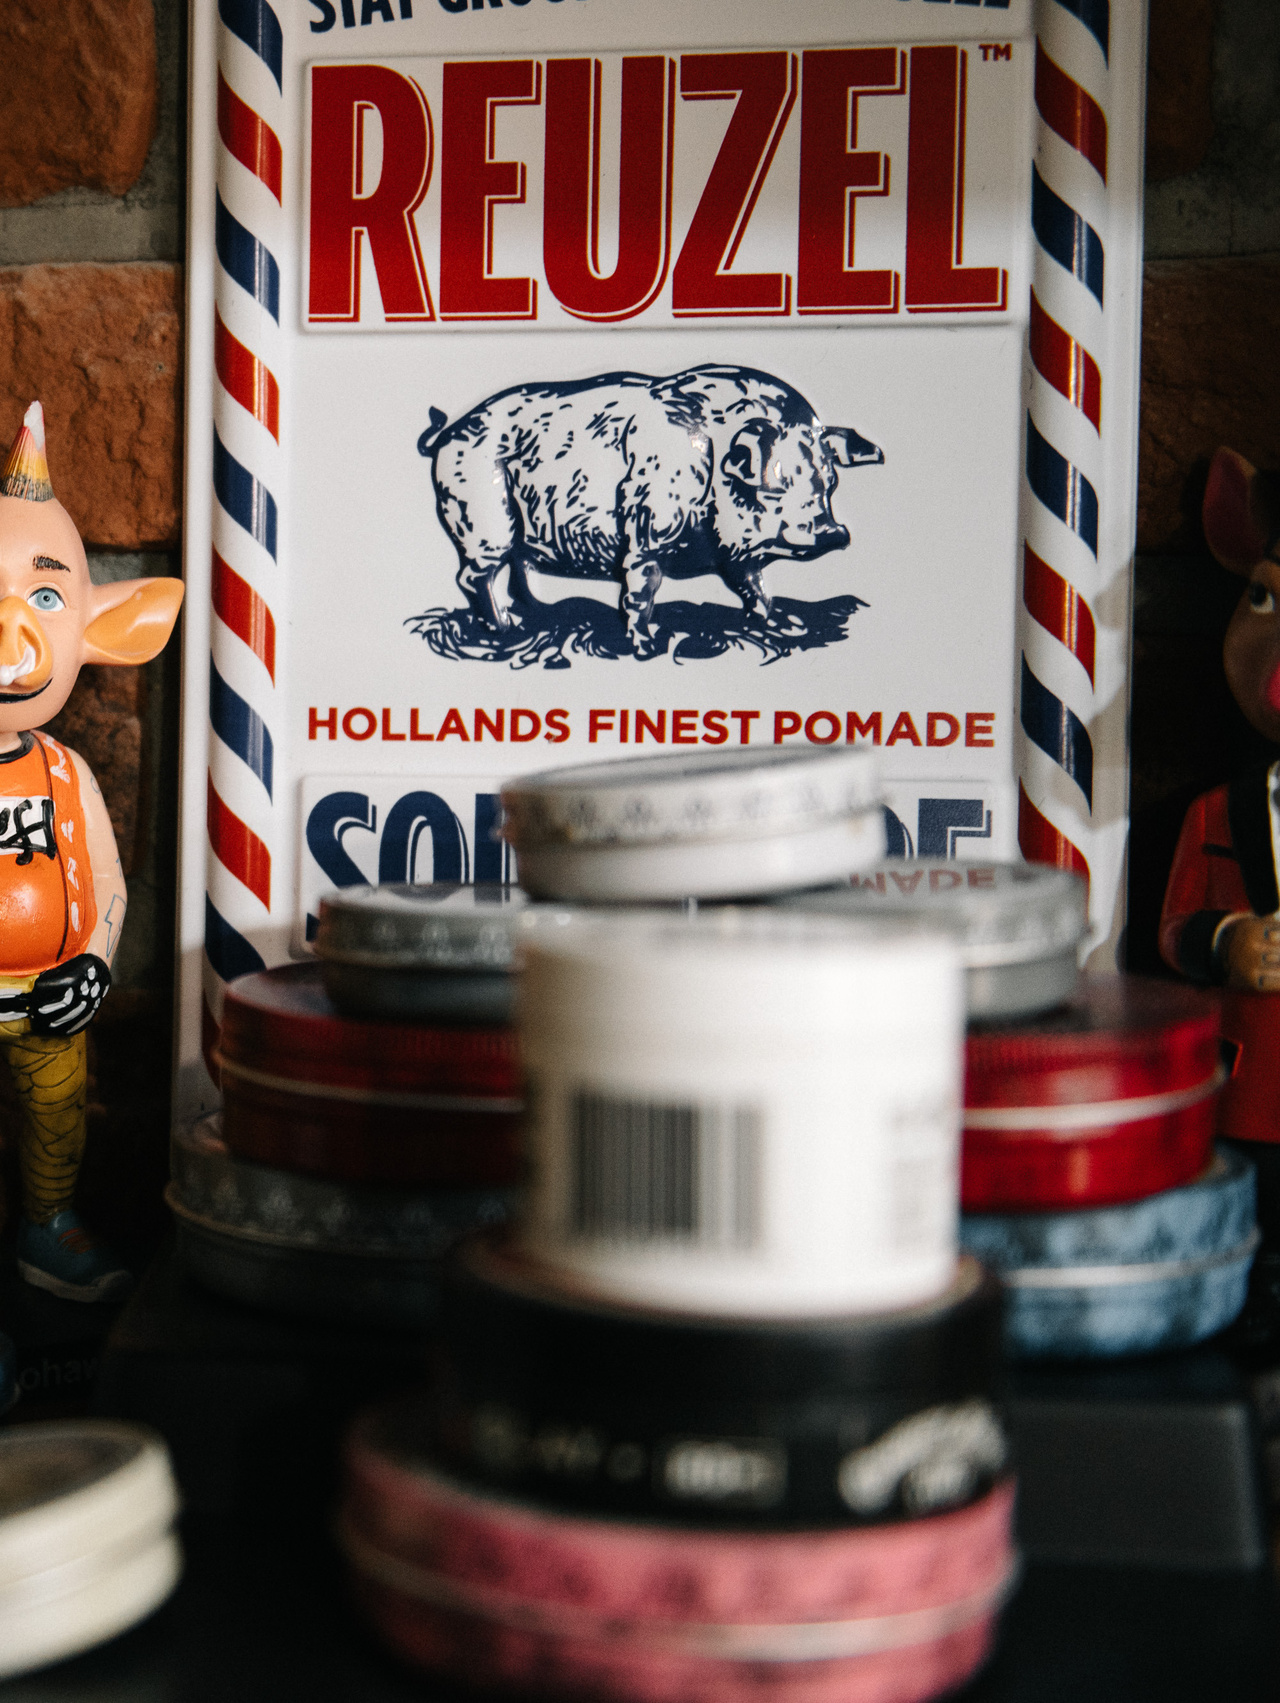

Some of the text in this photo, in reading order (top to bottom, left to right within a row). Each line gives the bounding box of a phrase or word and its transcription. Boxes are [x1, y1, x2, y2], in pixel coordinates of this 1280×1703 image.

[308, 45, 1009, 322] REUZEL
[308, 707, 996, 748] HOLLANDS FINEST POMADE
